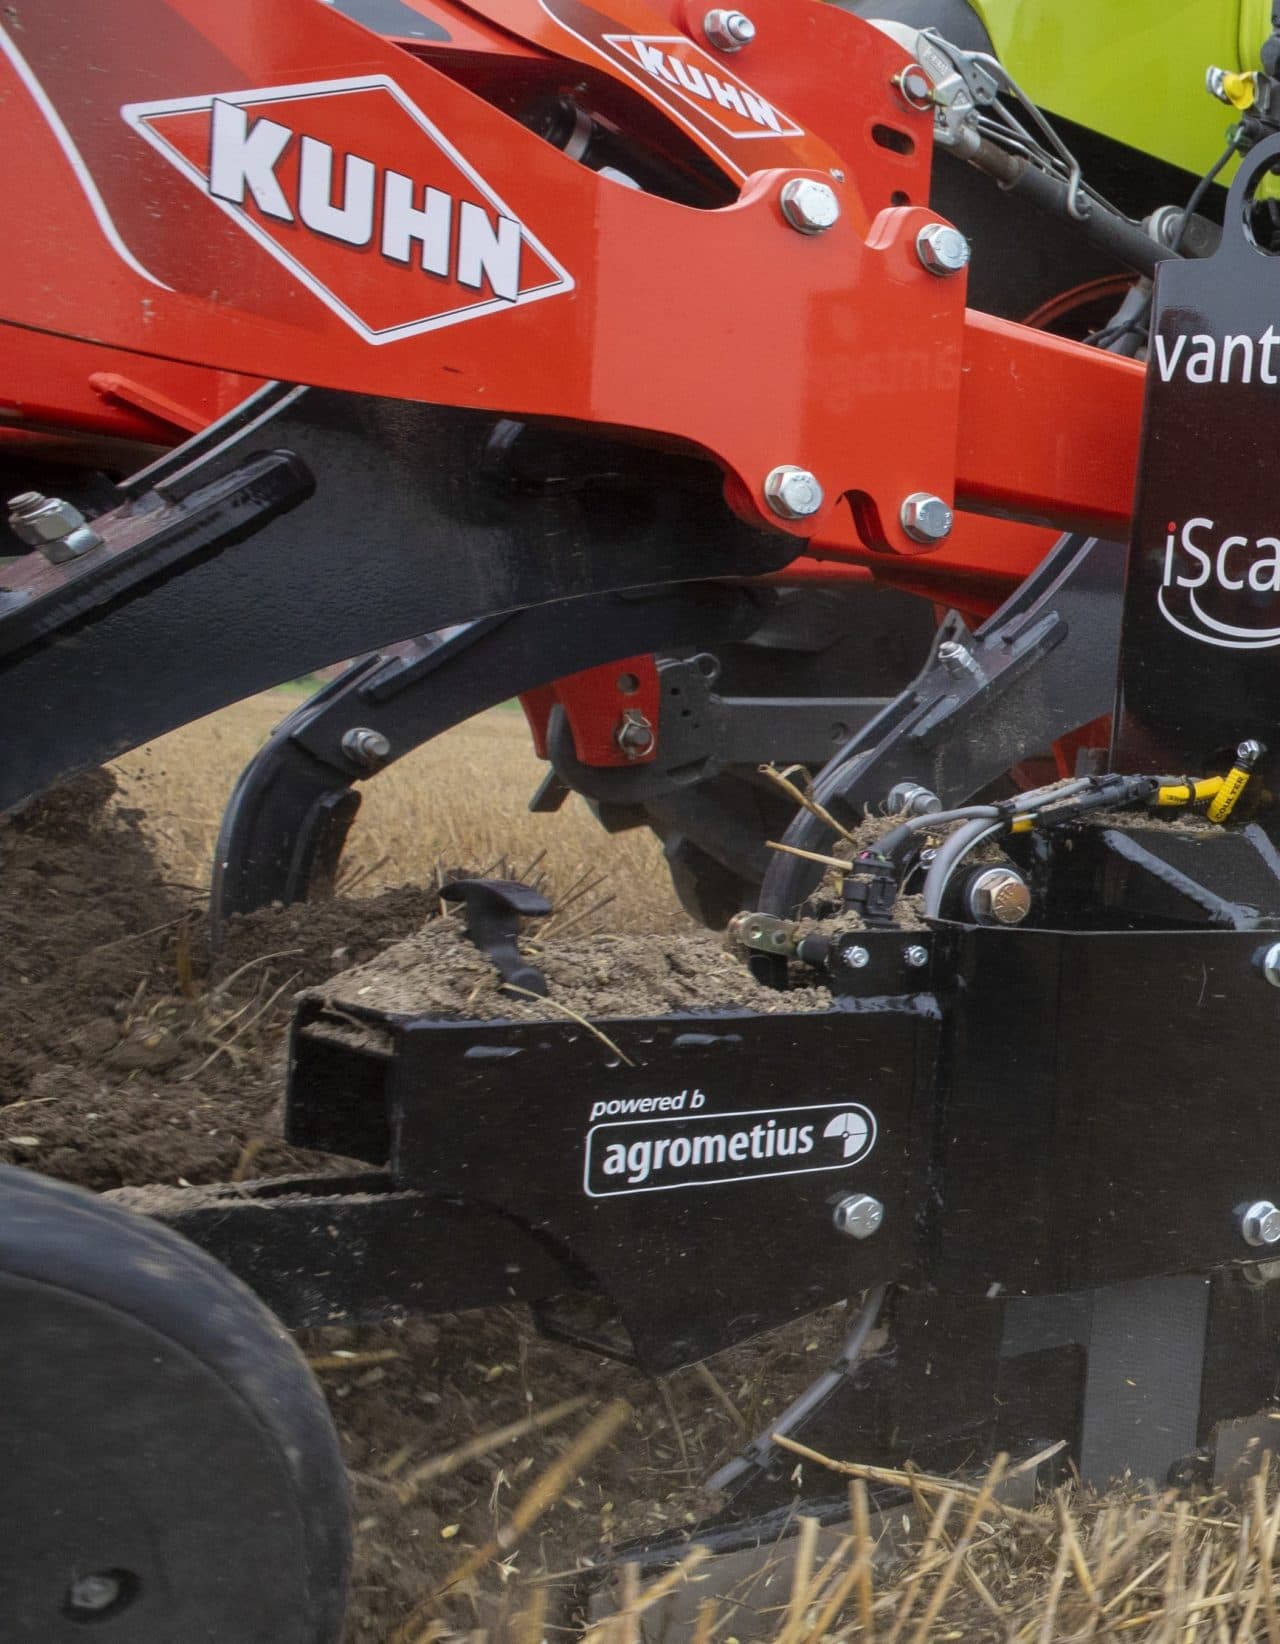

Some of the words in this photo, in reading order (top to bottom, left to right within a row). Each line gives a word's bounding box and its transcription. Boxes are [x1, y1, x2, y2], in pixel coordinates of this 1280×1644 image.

[630, 36, 784, 135] KUHN
[209, 97, 522, 303] KUHN
[1215, 776, 1244, 819] COULTER
[588, 1090, 688, 1121] powered
[689, 1089, 706, 1109] b
[602, 1119, 815, 1184] agrometius
